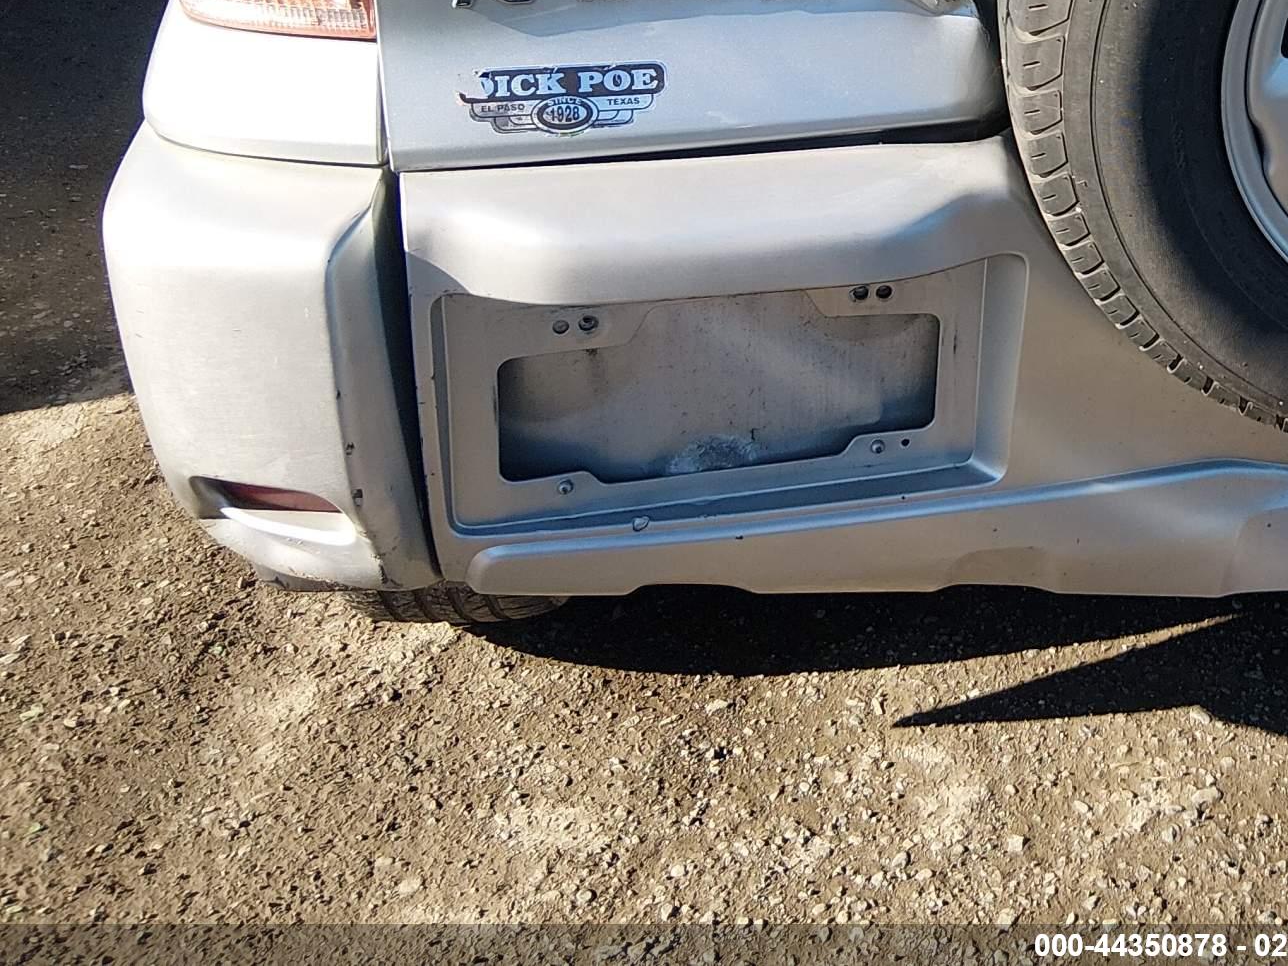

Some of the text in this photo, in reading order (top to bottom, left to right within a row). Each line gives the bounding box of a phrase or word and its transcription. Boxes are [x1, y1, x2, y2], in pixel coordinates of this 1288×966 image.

[577, 68, 659, 94] POE
[480, 103, 526, 113] EL PASO
[607, 97, 641, 107] TEXAS
[550, 106, 580, 123] 1928
